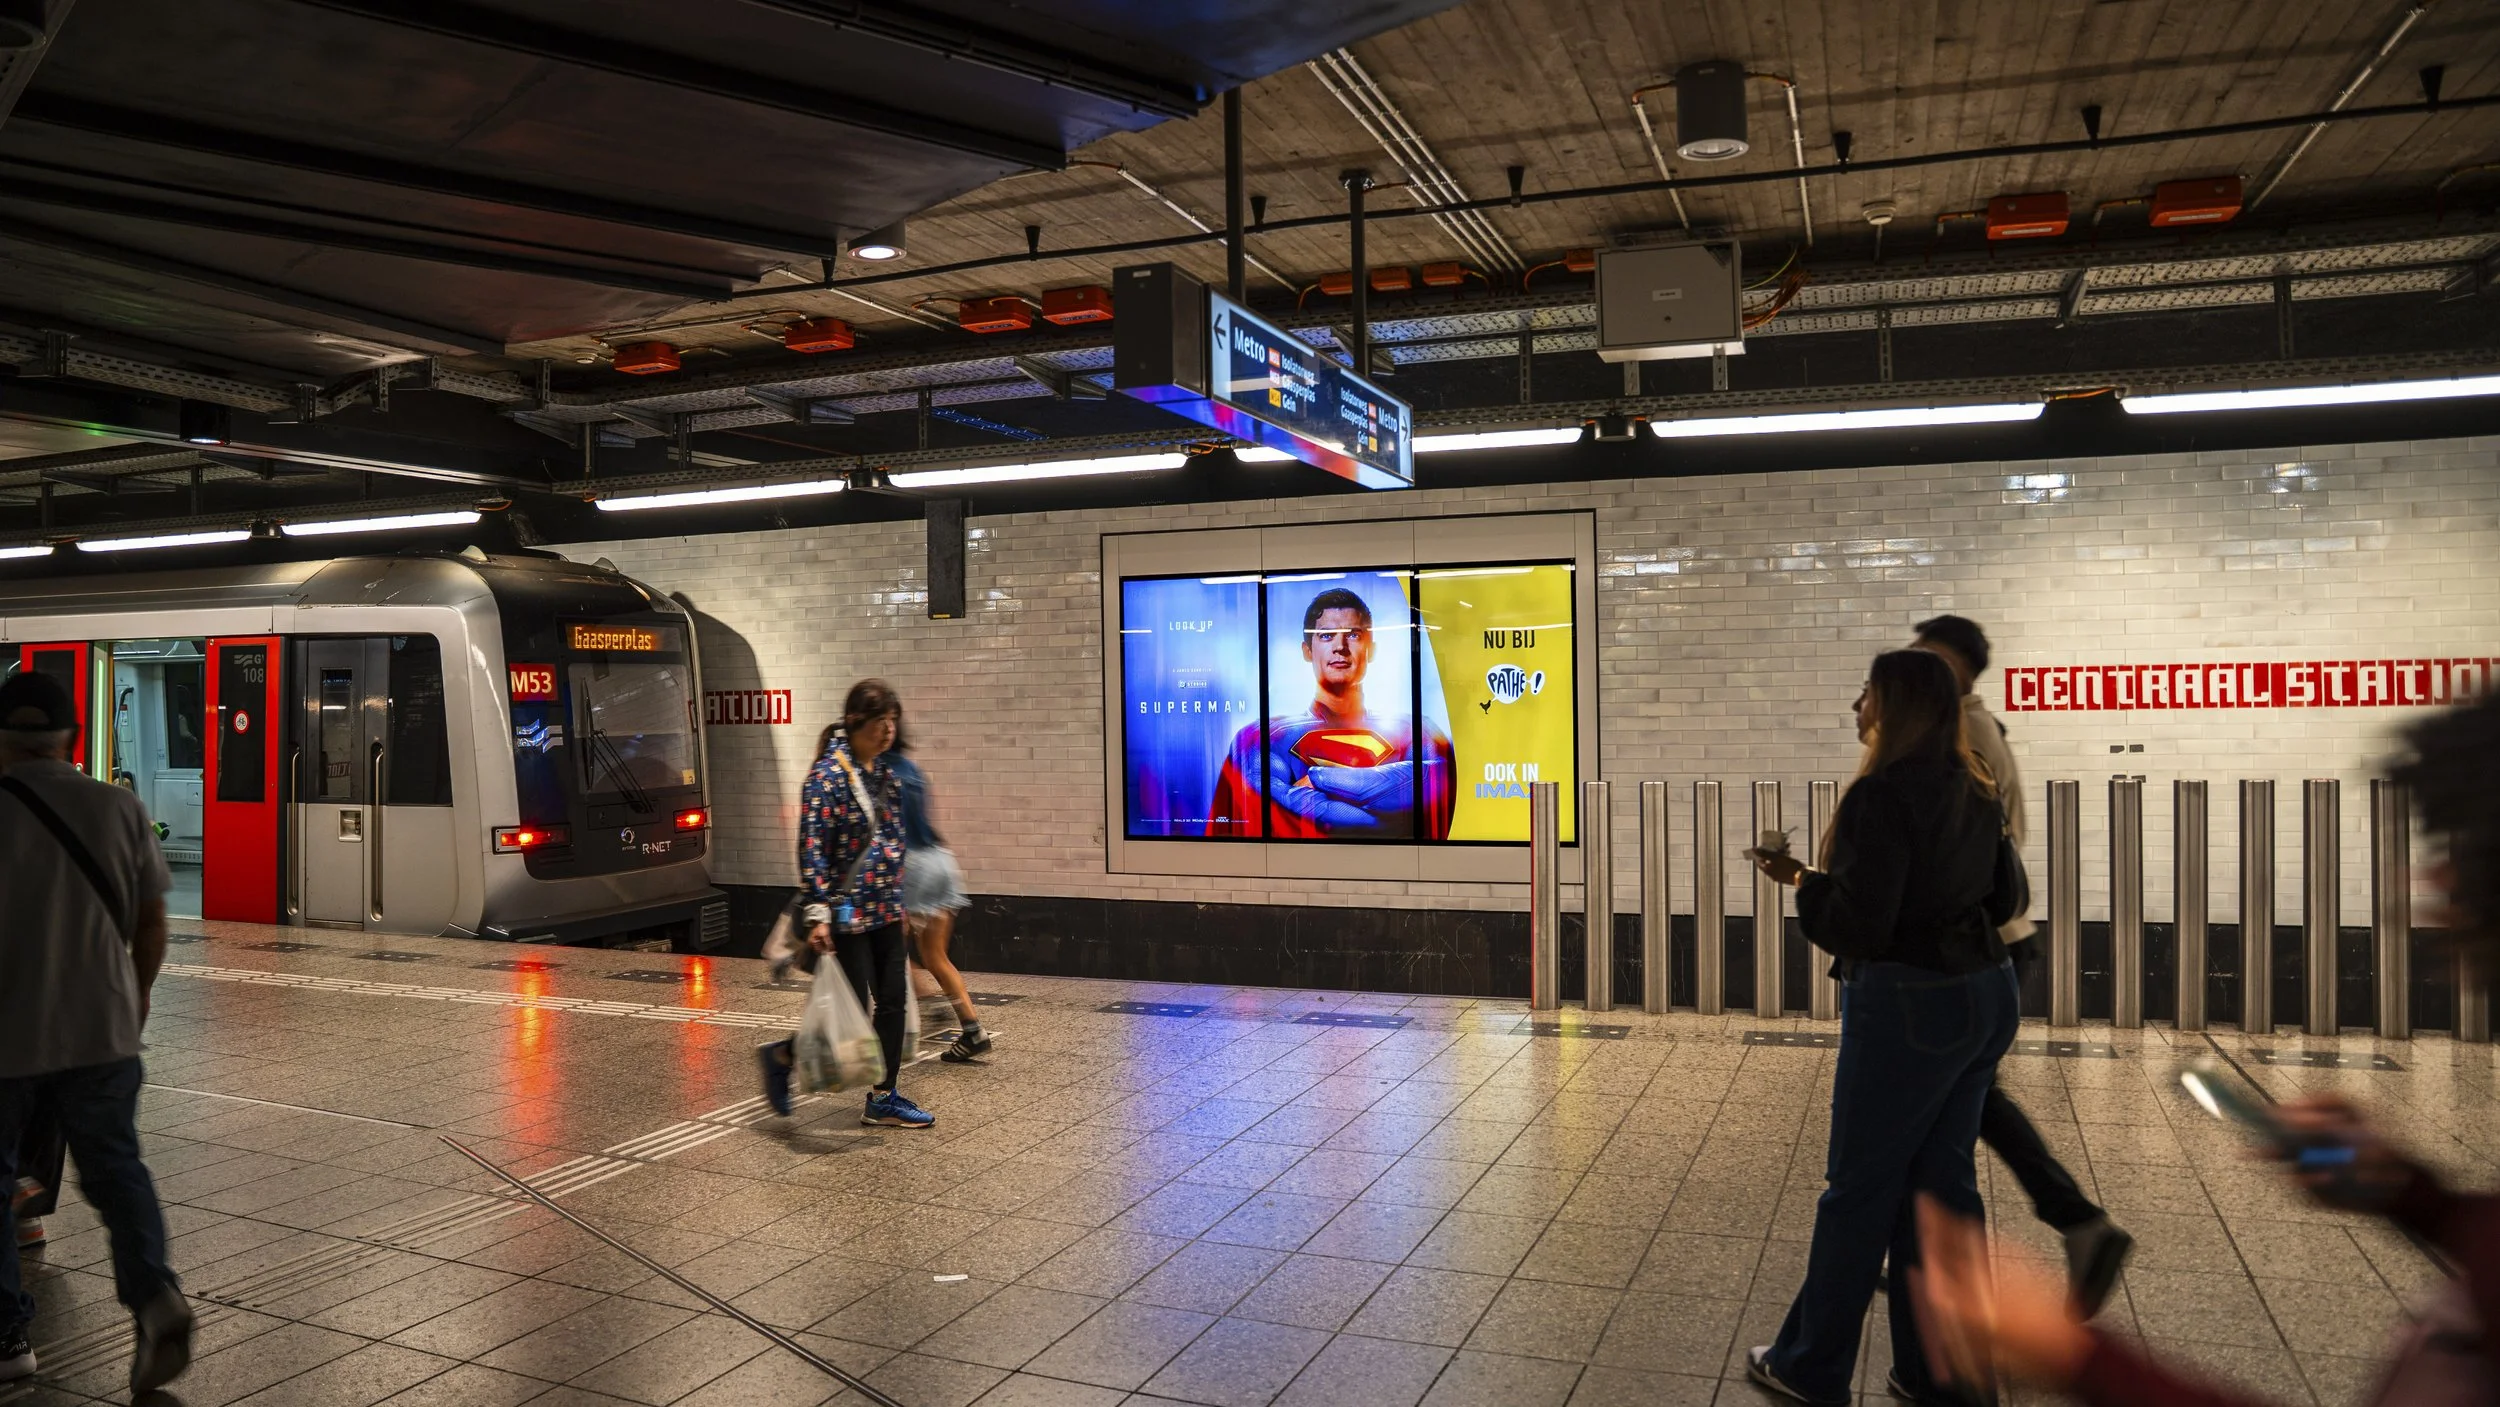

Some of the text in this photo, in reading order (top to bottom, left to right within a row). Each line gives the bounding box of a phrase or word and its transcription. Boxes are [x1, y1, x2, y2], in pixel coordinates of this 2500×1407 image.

[1234, 326, 1266, 364] Metro
[1282, 394, 1297, 413] Gein
[1379, 407, 1398, 433] Metro
[1170, 620, 1213, 631] LOOK UP
[574, 626, 652, 651] Gaasperplas
[1484, 629, 1535, 649] NU BIJ
[243, 668, 264, 684] 108
[511, 671, 552, 693] M53
[2011, 667, 2270, 706] CENTRAAL
[1140, 700, 1246, 714] SUPERMAN
[1484, 763, 1539, 782] OOK IN
[1475, 783, 1531, 798] IMA
